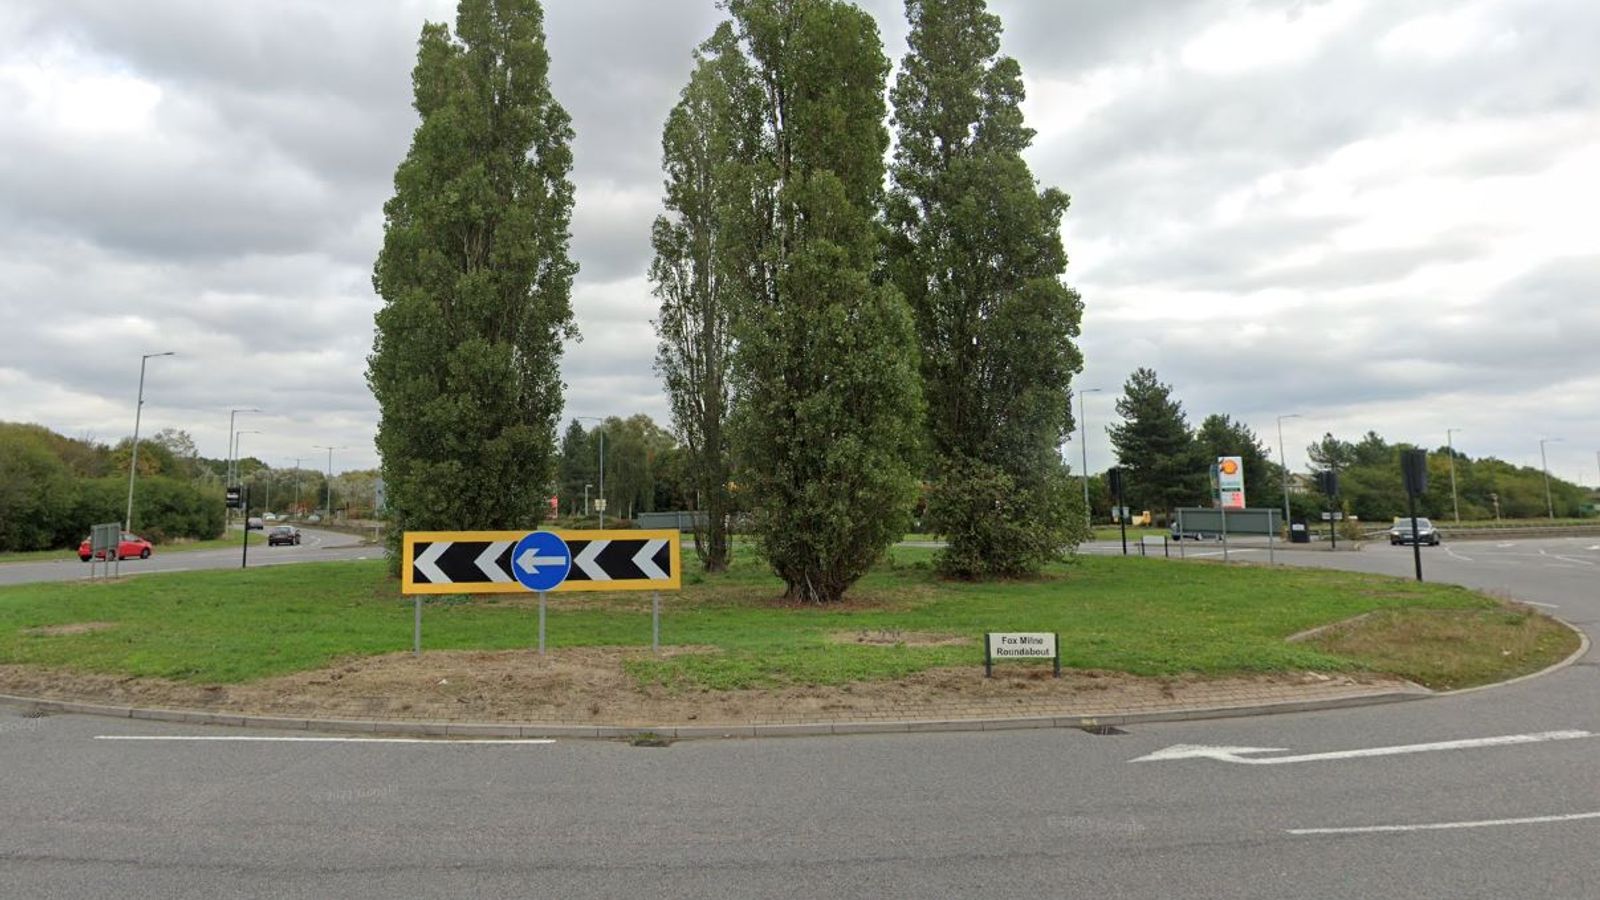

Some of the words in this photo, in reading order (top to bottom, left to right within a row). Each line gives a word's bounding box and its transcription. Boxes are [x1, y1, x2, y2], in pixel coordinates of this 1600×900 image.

[1001, 636, 1018, 645] Fox
[1019, 636, 1044, 645] Milne
[996, 647, 1050, 656] Roundabout
